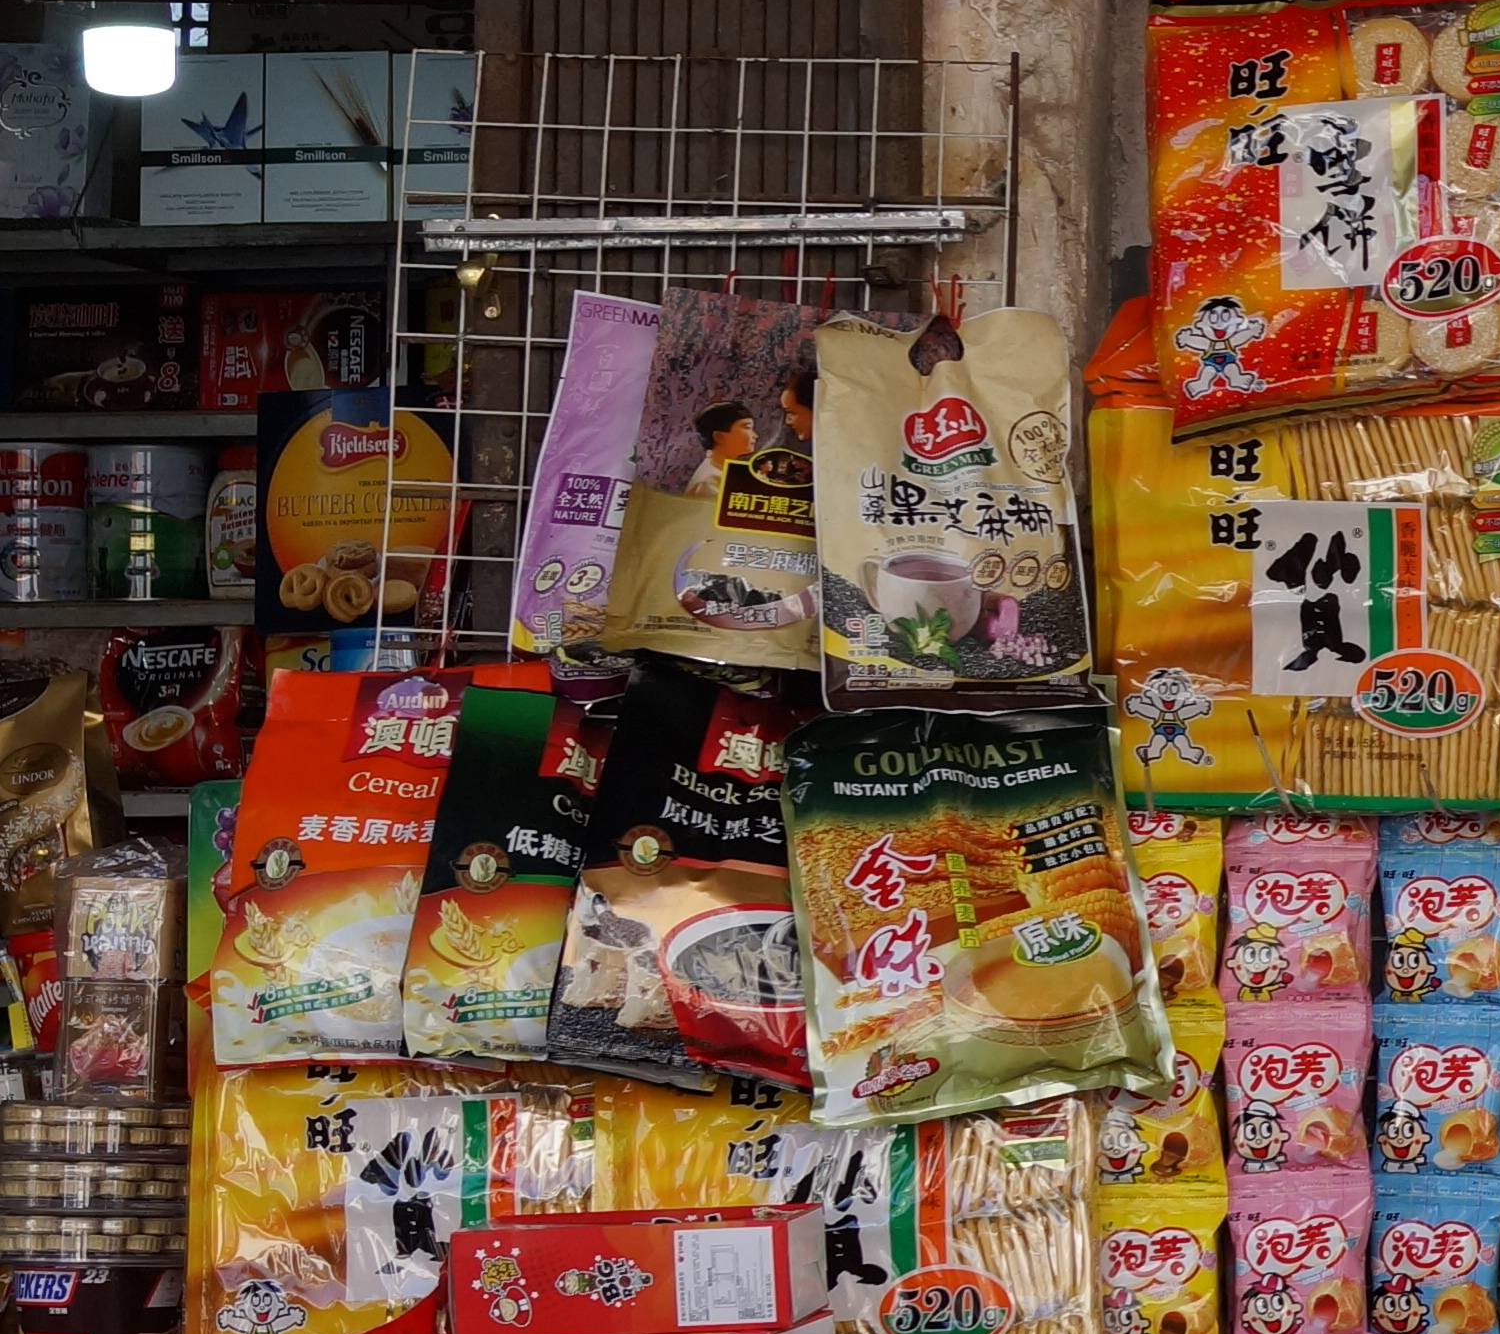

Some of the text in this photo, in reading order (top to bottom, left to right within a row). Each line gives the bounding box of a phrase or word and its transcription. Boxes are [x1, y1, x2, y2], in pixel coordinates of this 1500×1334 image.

[1228, 51, 1292, 168] 旺旺
[1398, 255, 1496, 304] 520g
[274, 490, 356, 520] BUTTER
[552, 509, 598, 524] NATURE
[554, 490, 604, 511] 全天然
[1208, 438, 1265, 551] 旺旺
[138, 671, 202, 681] ORIGINAL
[1370, 669, 1471, 715] 520g
[10, 767, 56, 786] LINDOR
[347, 770, 441, 802] Cereal
[833, 780, 908, 797] INSTANT
[1003, 761, 1078, 787] CEREAL
[1253, 875, 1332, 926] 泡芙
[1406, 880, 1486, 928] 泡芙
[1011, 910, 1089, 961] 原味
[1107, 1233, 1187, 1280] 泡芙
[1253, 1219, 1331, 1269] 泡芙
